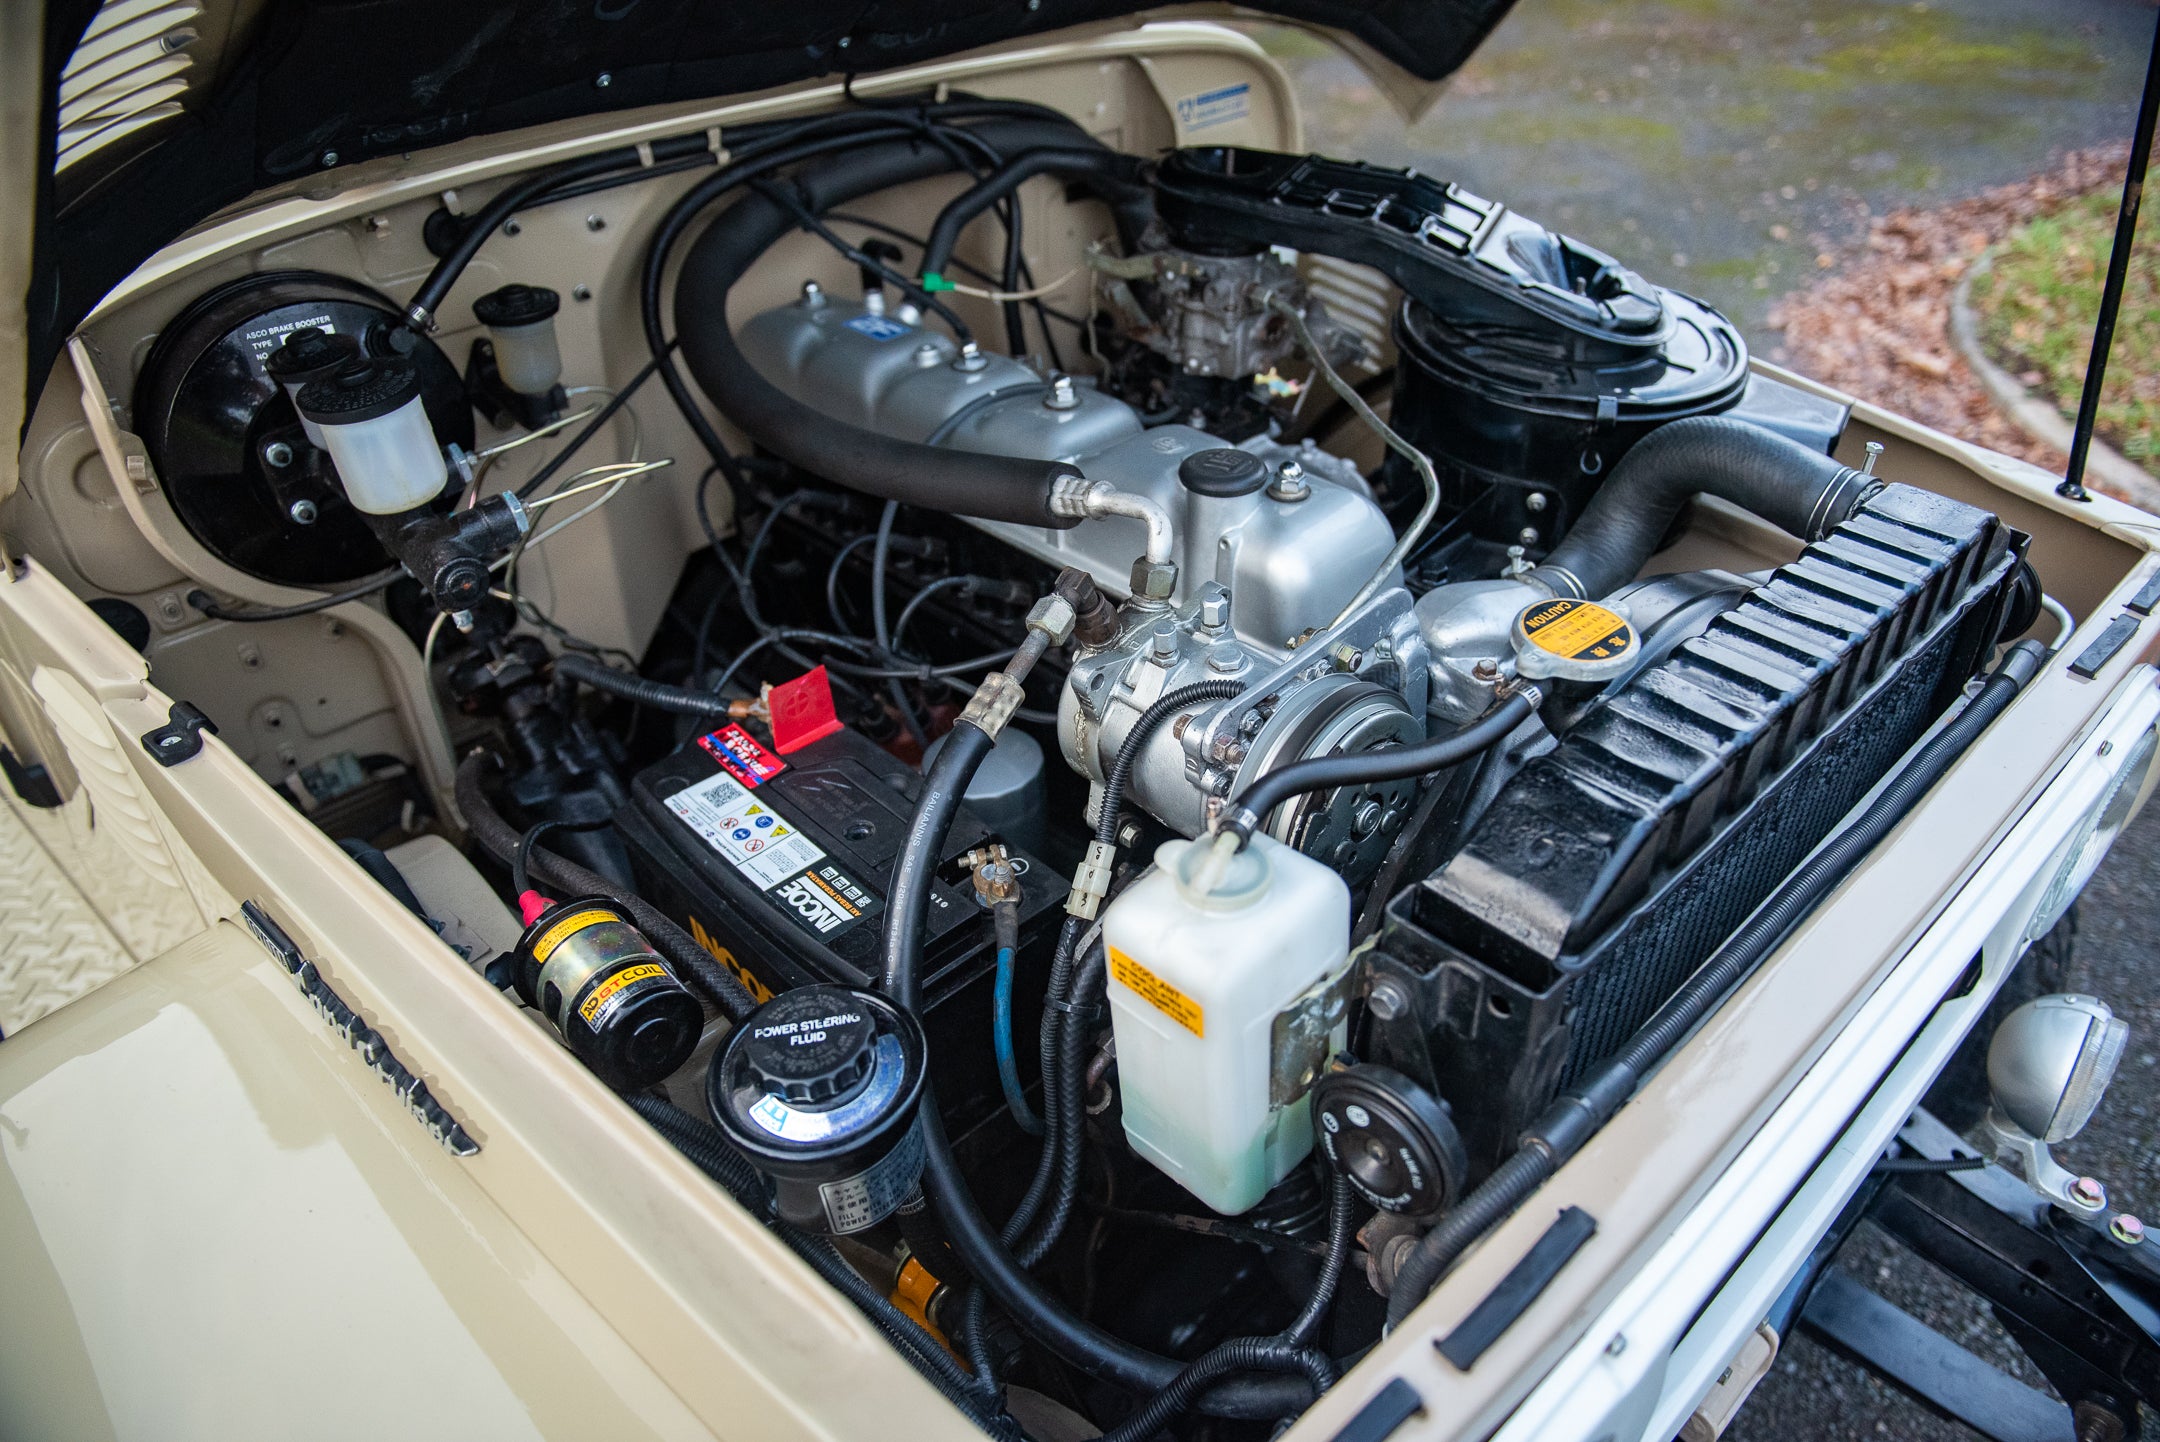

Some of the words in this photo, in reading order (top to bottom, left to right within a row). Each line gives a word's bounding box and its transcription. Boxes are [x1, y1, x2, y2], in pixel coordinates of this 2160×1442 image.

[246, 329, 268, 340] ASCO
[268, 322, 296, 335] BRAKE
[295, 315, 331, 329] BOOSTER
[252, 339, 273, 350] TYPE
[256, 352, 269, 361] NO
[1526, 601, 1572, 628] CAUTION
[912, 791, 941, 847] BAILIANNIS
[904, 854, 915, 873] SAE
[776, 880, 843, 934] INCOE
[599, 978, 620, 999] GT
[622, 963, 662, 982] COIL
[754, 1021, 799, 1039] POWER
[799, 1012, 861, 1031] STEERING
[790, 1031, 827, 1047] FLUID
[840, 1215, 868, 1228] POWER
